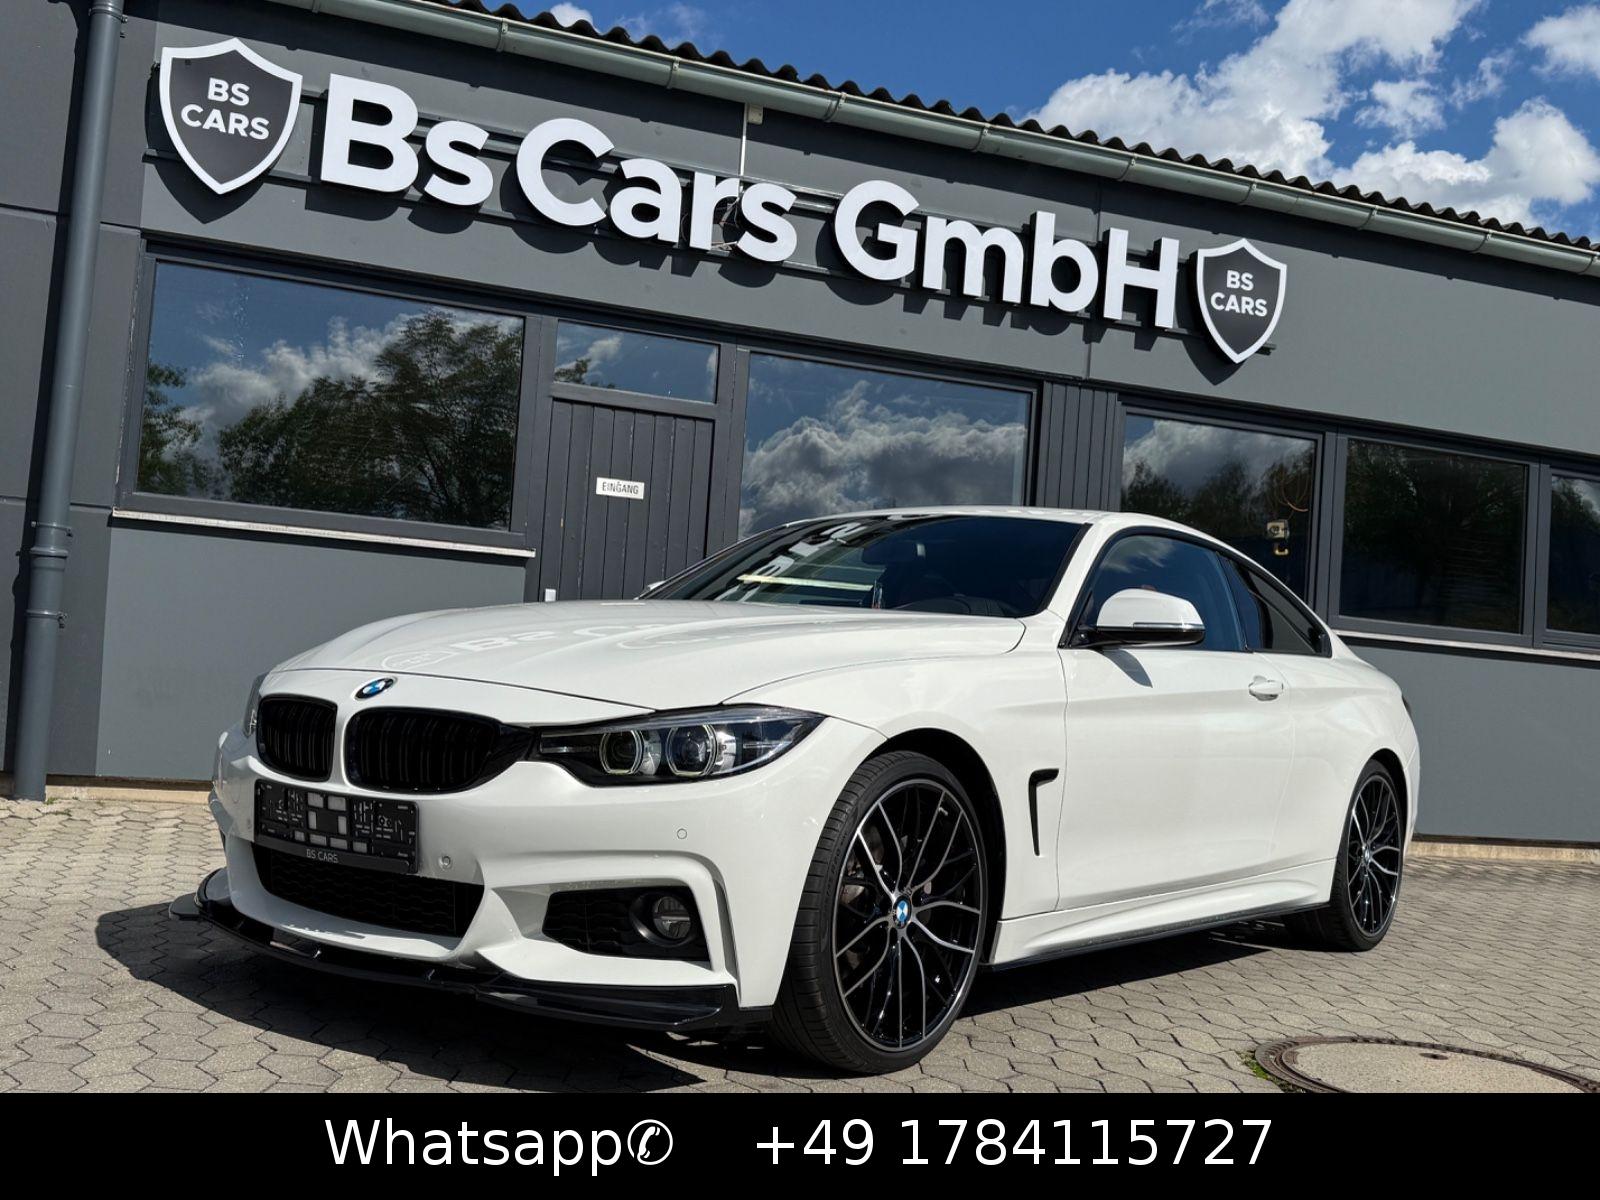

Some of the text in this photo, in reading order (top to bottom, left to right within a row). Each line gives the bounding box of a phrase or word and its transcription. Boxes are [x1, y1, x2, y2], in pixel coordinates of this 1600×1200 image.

[207, 77, 250, 107] BS
[180, 103, 270, 140] CARS
[320, 73, 1180, 329] Bs Cars GmbH
[1226, 269, 1255, 292] BS
[1210, 291, 1268, 317] CARS
[602, 481, 639, 495] EINGANG
[306, 848, 339, 864] BS CARS
